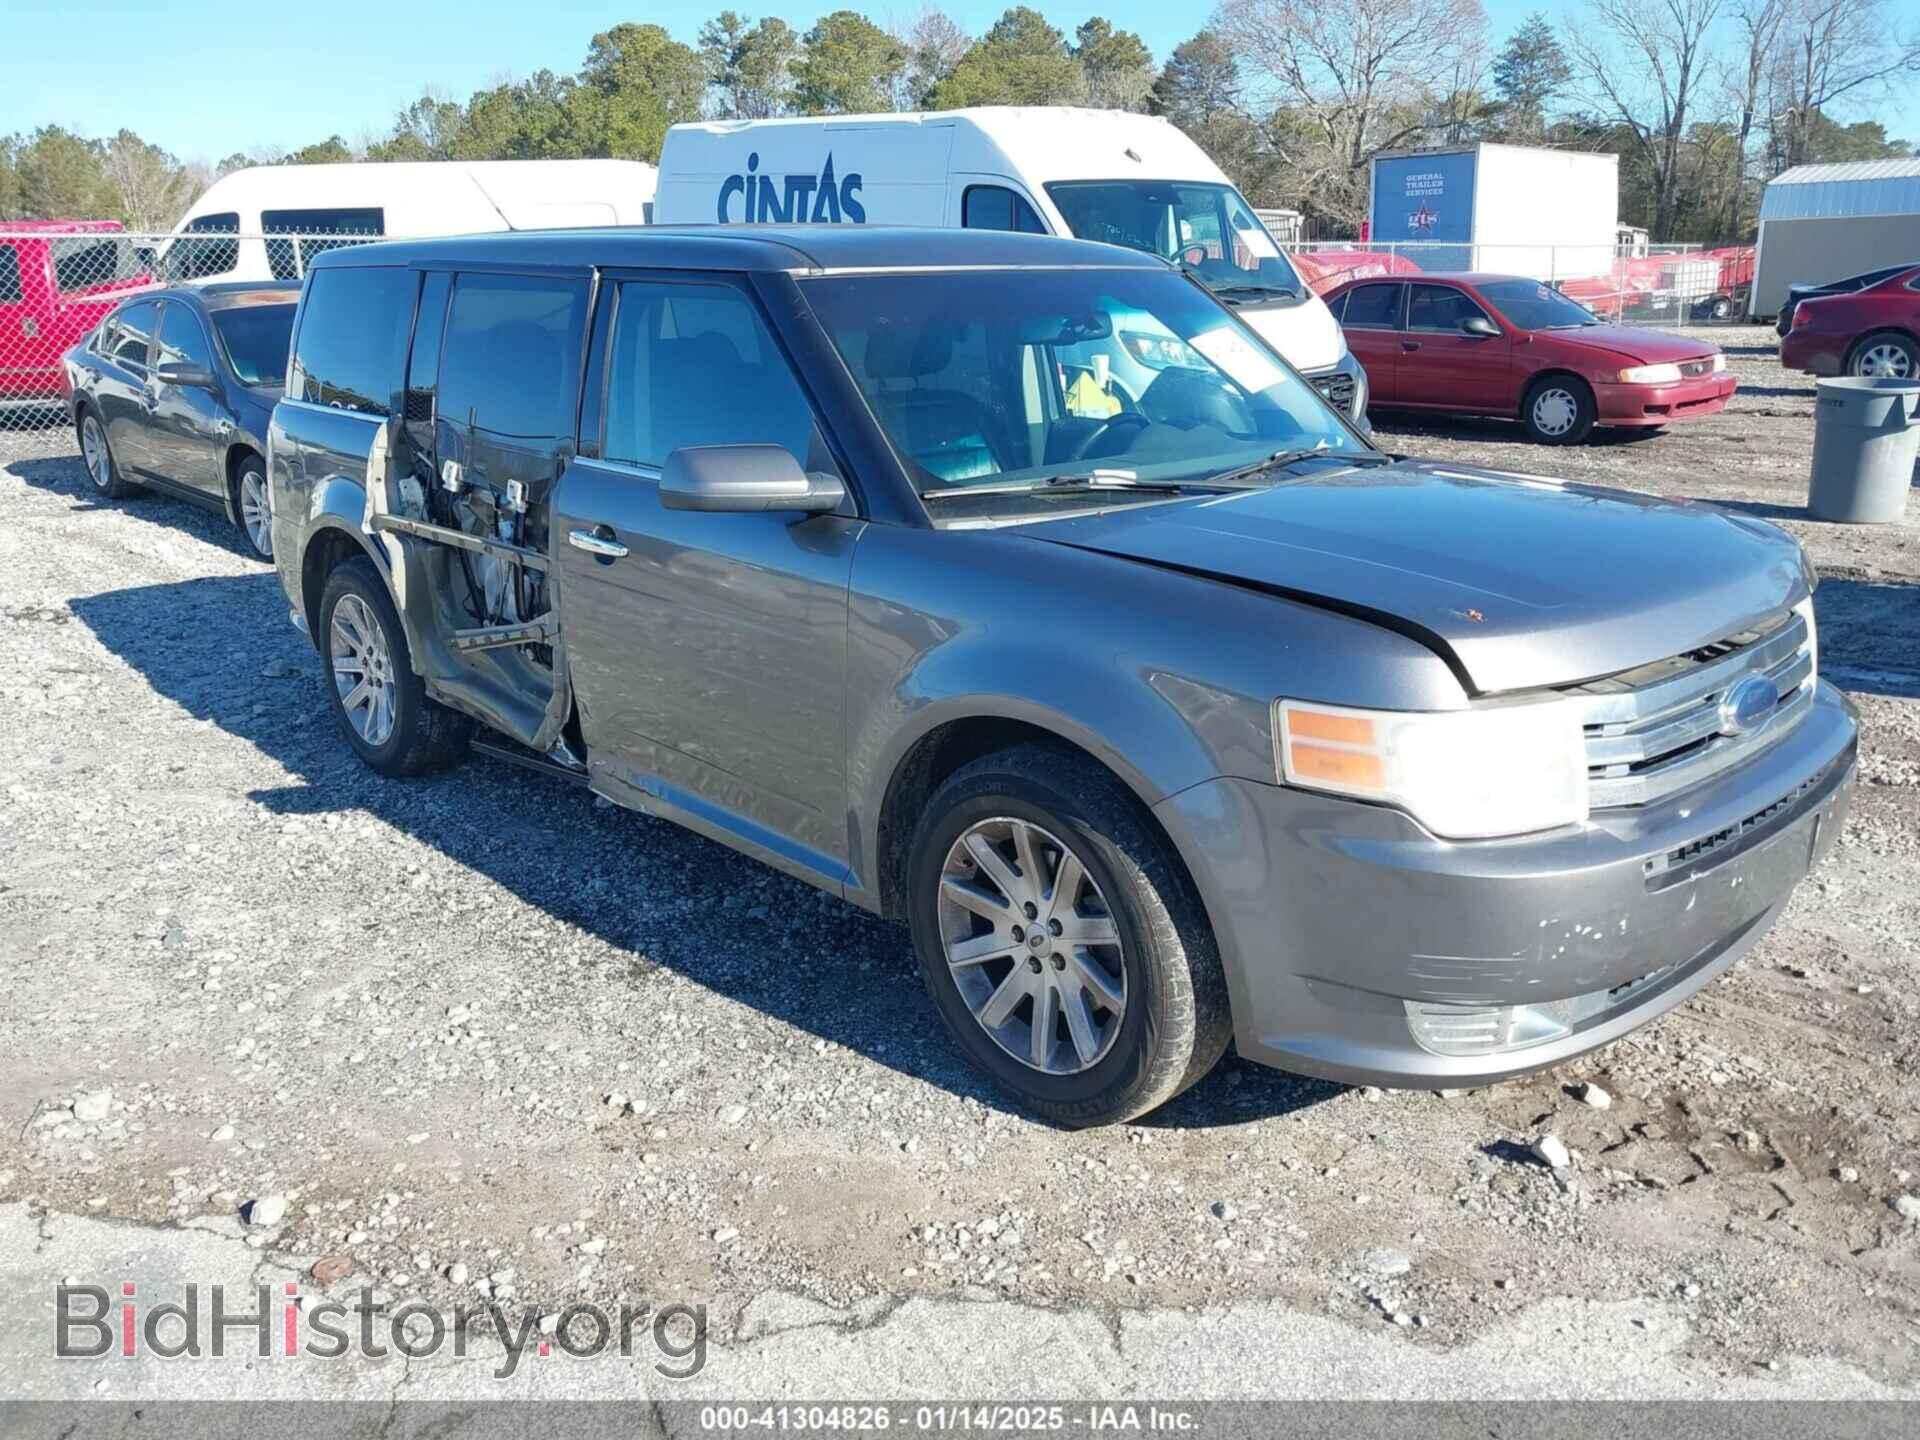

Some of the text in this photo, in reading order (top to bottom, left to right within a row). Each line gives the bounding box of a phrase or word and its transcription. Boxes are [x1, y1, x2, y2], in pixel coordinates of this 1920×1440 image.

[1406, 173, 1444, 181] GENERAL
[1406, 180, 1443, 189] TRAILER
[1406, 188, 1443, 197] SERVICES
